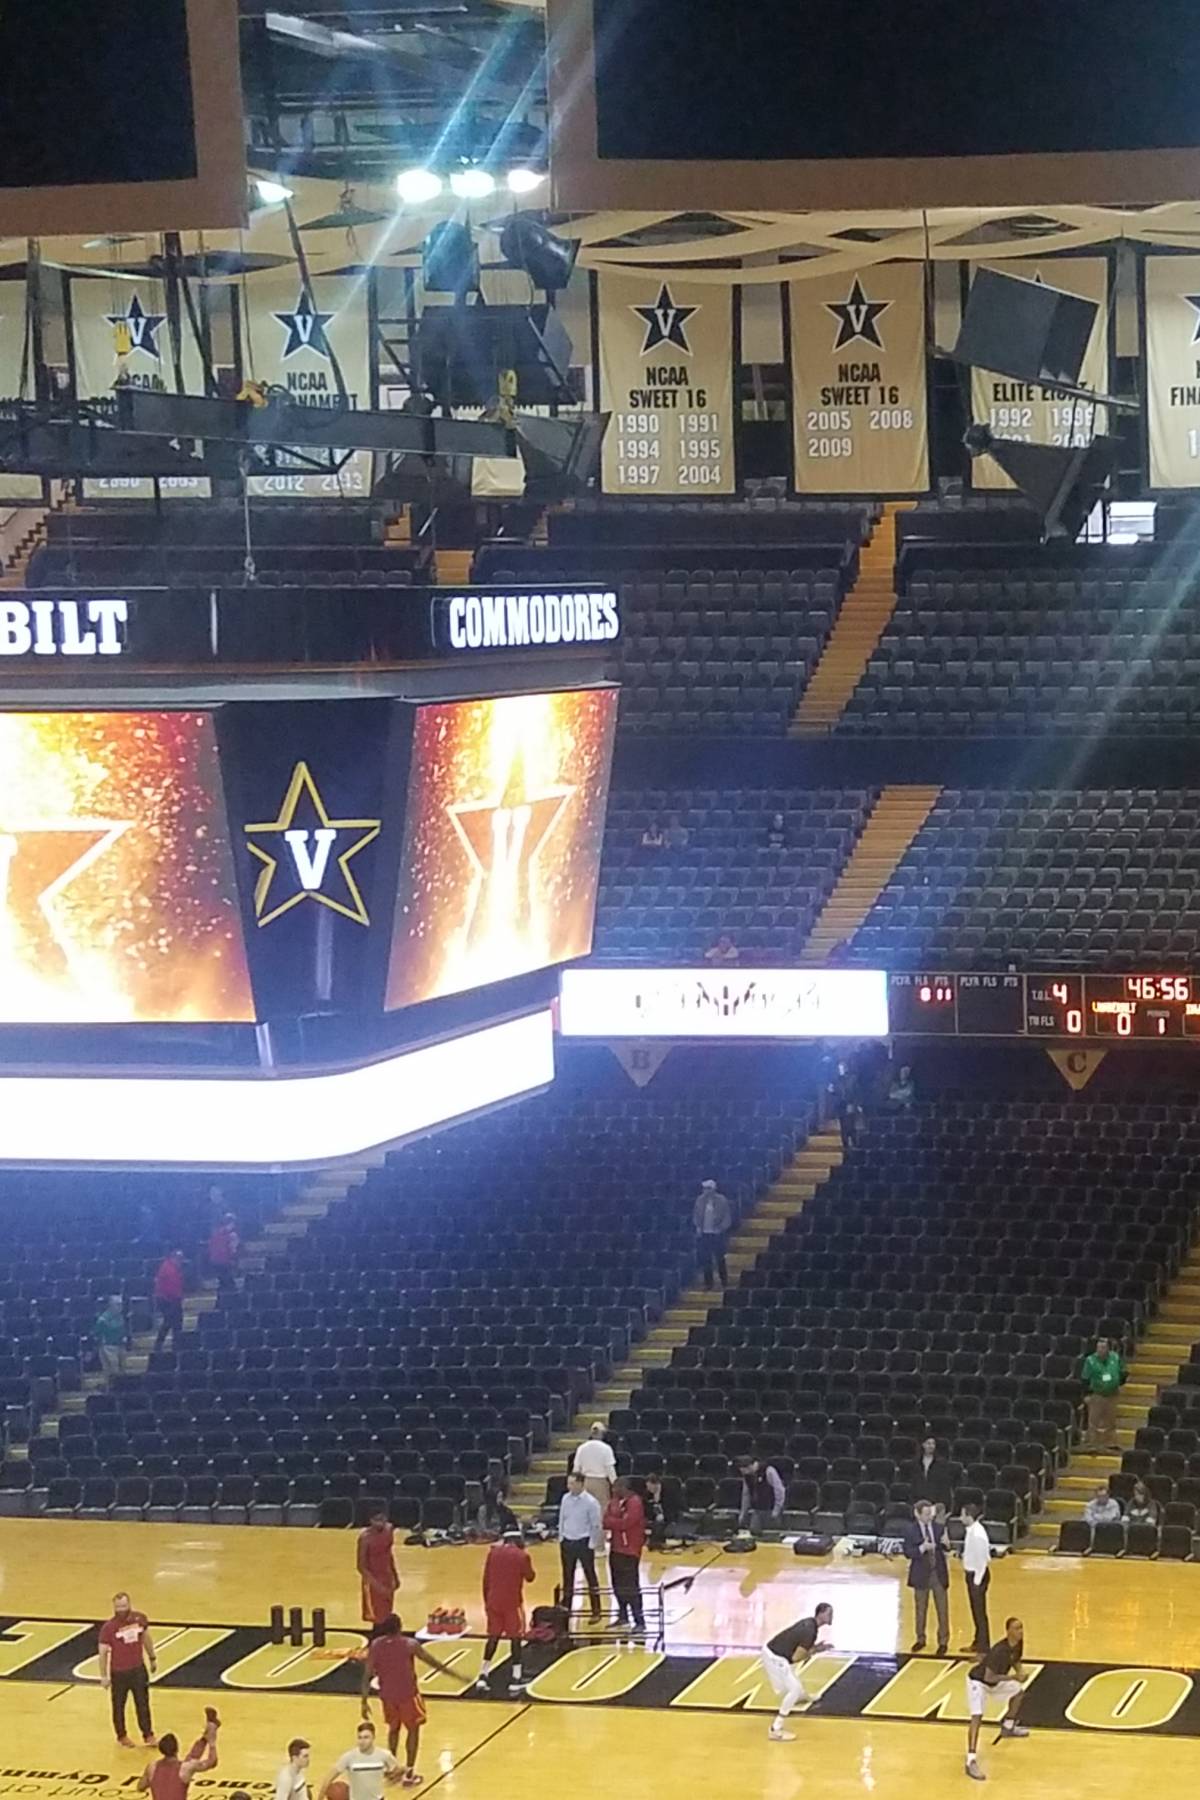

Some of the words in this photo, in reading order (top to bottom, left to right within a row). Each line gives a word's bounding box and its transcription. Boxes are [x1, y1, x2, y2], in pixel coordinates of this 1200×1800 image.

[293, 315, 313, 343] V
[655, 309, 676, 336] V
[847, 304, 868, 336] V
[126, 317, 147, 345] V
[286, 371, 328, 391] NCAA
[645, 366, 689, 387] NCAA
[838, 363, 881, 383] NCAA
[628, 388, 677, 409] SWEET
[685, 388, 707, 408] 16
[820, 385, 869, 406] SWEET
[878, 385, 899, 405] 16
[992, 382, 1035, 402] ELITE
[616, 413, 661, 434] 1990
[679, 413, 719, 433] 1991
[807, 411, 851, 431] 2005
[869, 410, 914, 430] 2008
[989, 407, 1033, 428] 1992
[616, 439, 662, 460] 1994
[679, 439, 721, 460] 1995
[808, 437, 852, 457] 2009
[263, 475, 305, 492] 2012
[617, 465, 661, 485] 1997
[678, 465, 722, 485] 2004
[0, 600, 128, 655] BILT
[449, 592, 620, 649] COMMODORES
[283, 829, 337, 890] V
[983, 976, 998, 987] FLS
[1127, 977, 1189, 1001] 46:56
[1052, 983, 1067, 1005] 4
[1067, 1010, 1081, 1033] 0
[1117, 1013, 1131, 1035] 0
[1158, 1017, 1166, 1035] 1
[1067, 1053, 1087, 1074] C
